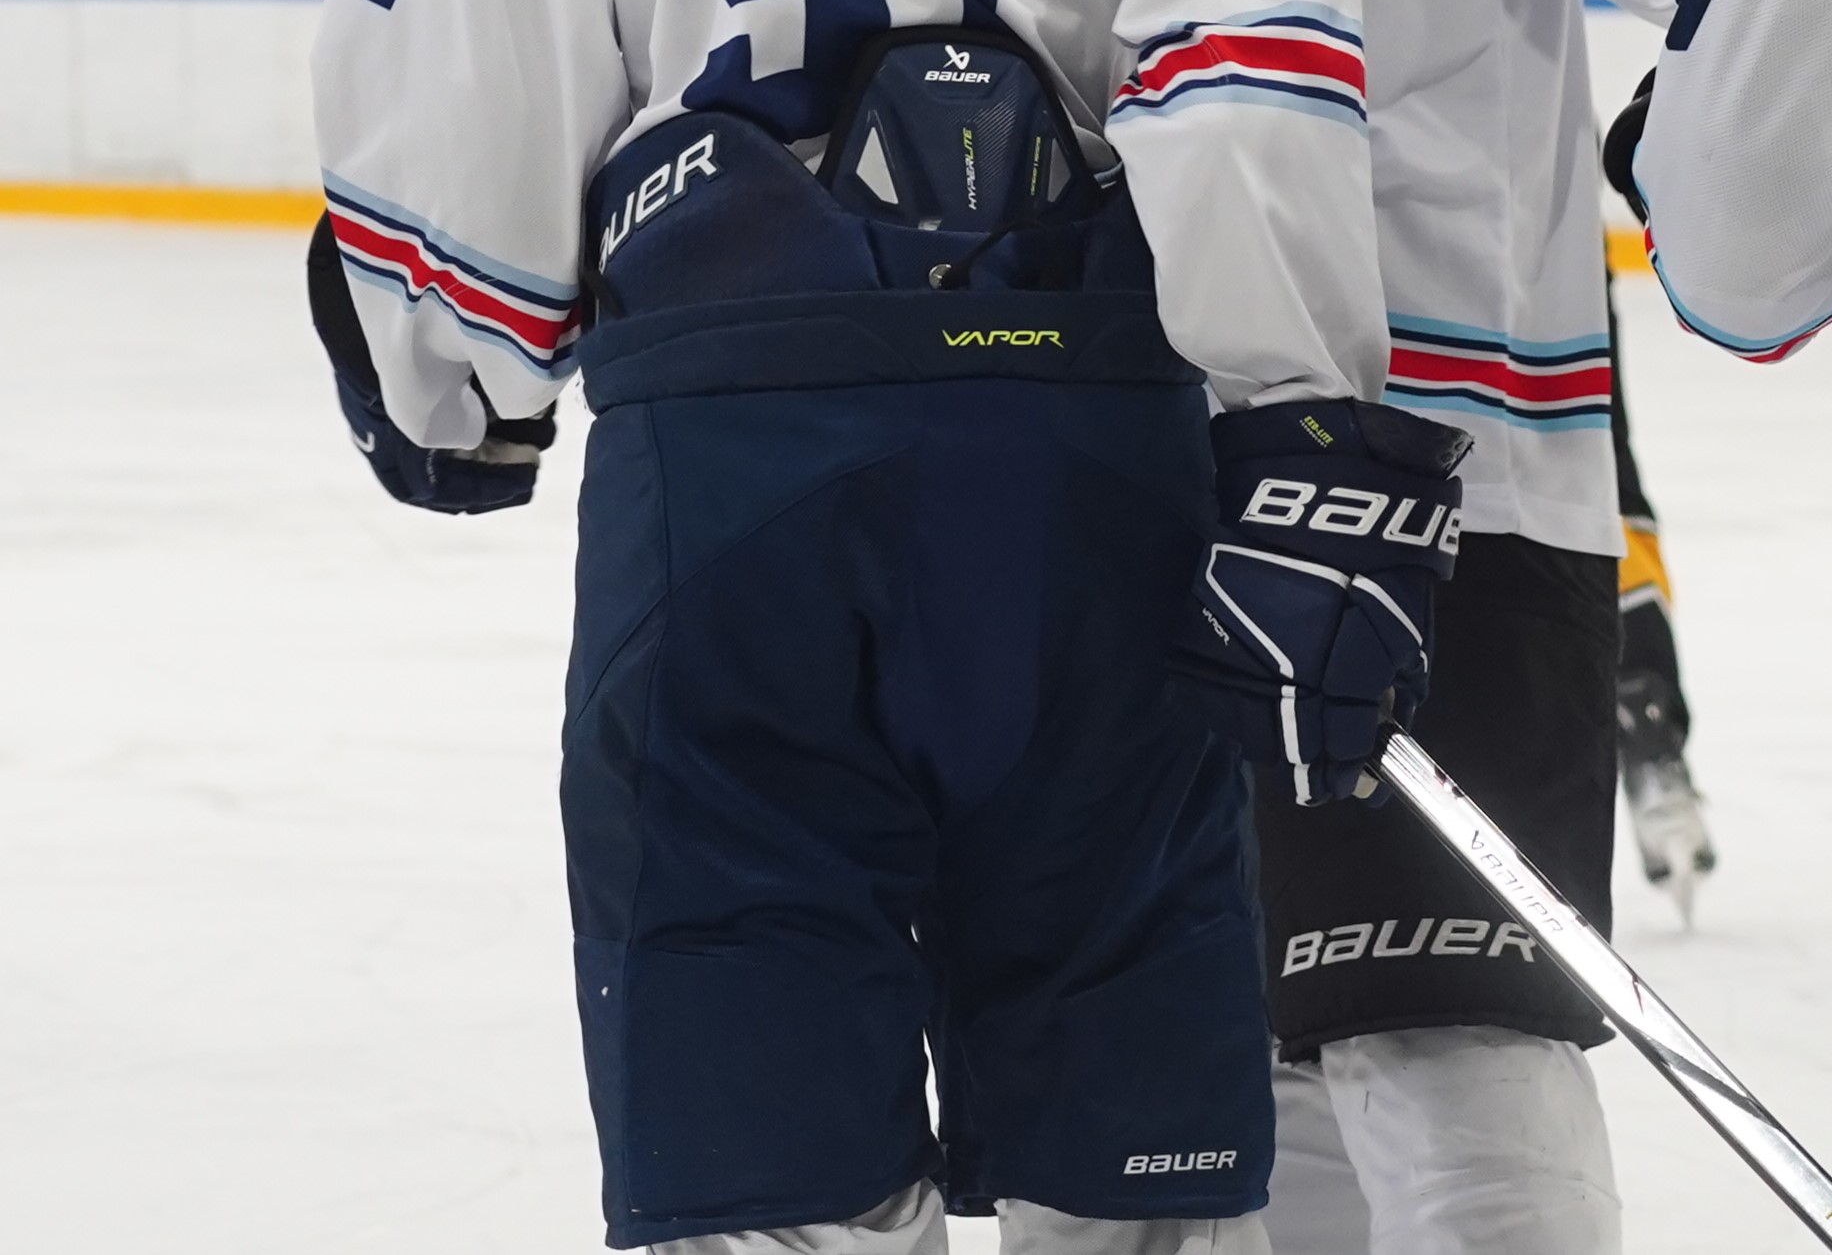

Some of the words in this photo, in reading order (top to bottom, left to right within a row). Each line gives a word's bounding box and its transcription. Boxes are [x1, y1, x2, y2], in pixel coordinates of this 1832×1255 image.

[924, 70, 991, 84] BAUER
[598, 132, 718, 275] AUER
[941, 329, 1065, 349] VAPOR
[1239, 477, 1464, 556] BAU
[1281, 916, 1537, 977] BAUER
[1123, 1149, 1238, 1175] BAUER
